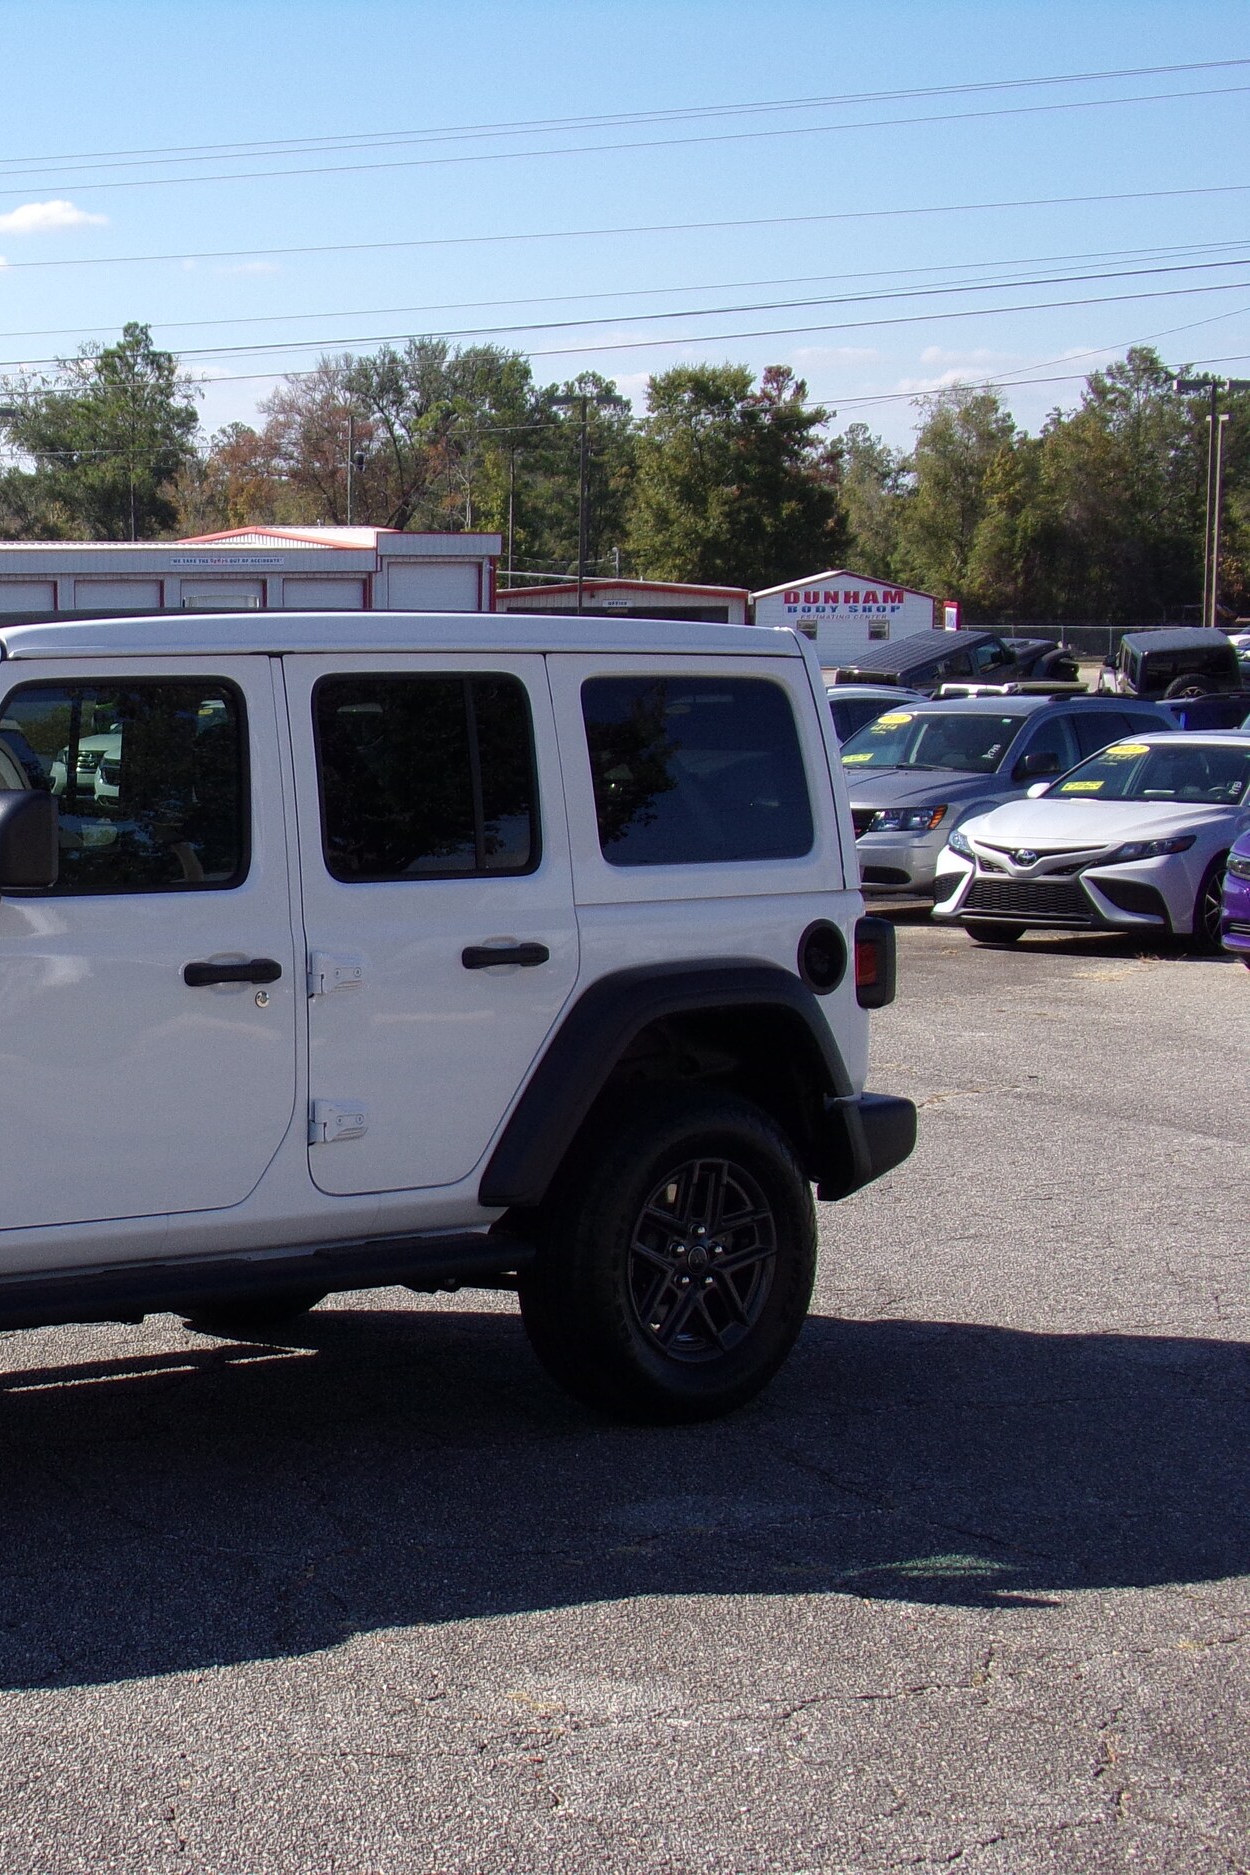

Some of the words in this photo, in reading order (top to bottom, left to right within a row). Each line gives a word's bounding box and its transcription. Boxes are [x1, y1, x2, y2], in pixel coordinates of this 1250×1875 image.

[784, 590, 905, 604] DUNHAM
[787, 605, 839, 613] BODY
[848, 605, 901, 613] SHOP
